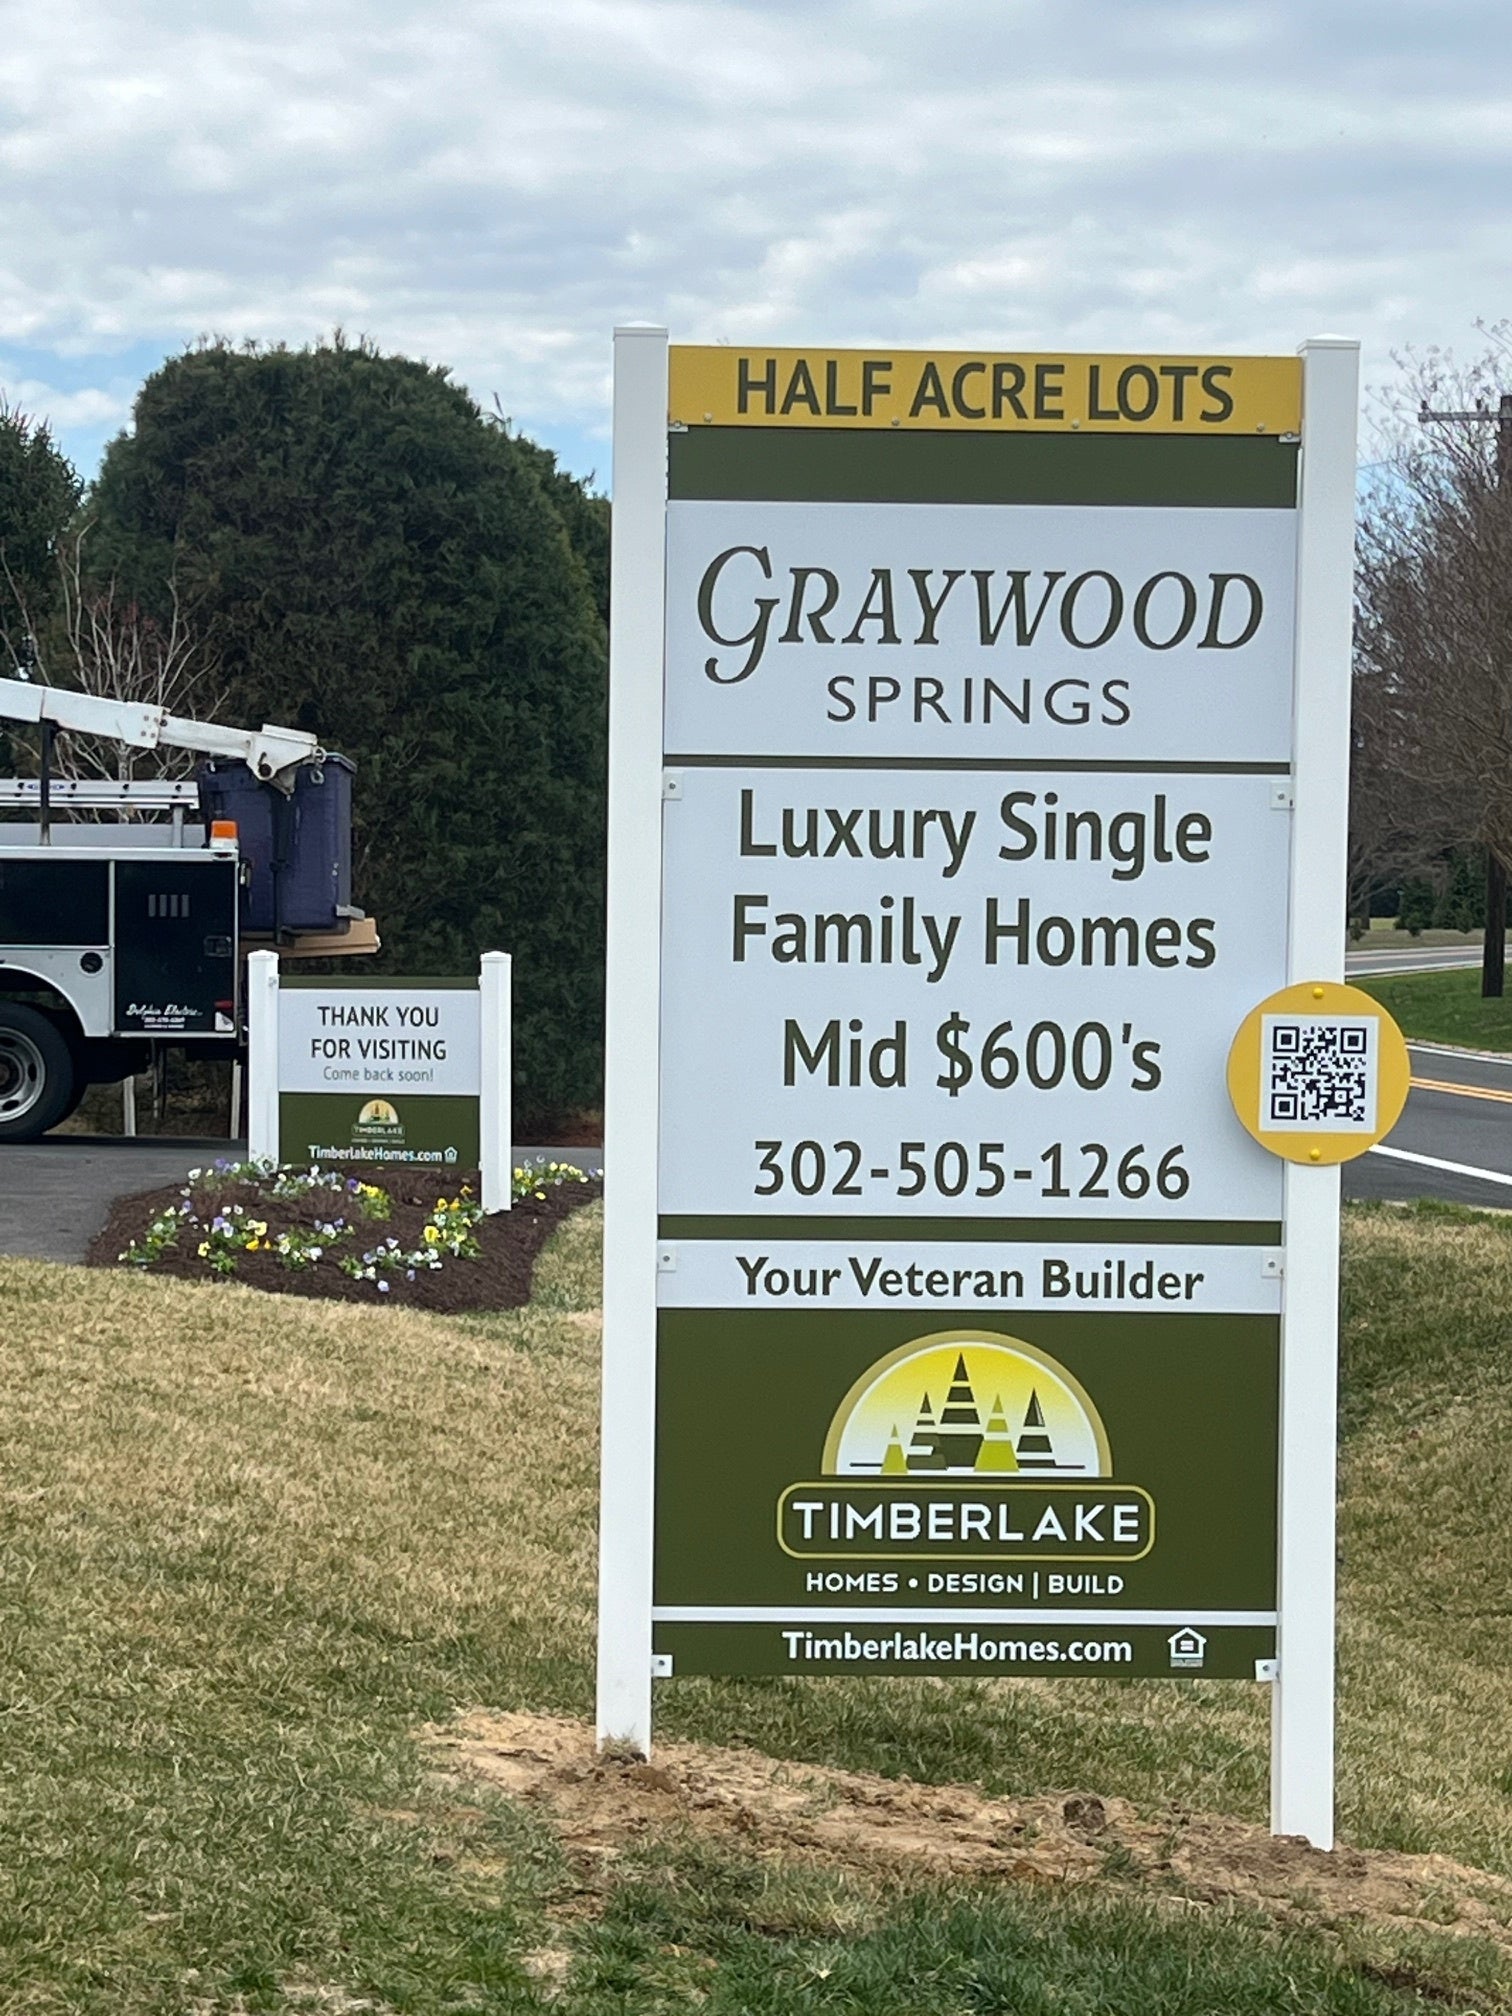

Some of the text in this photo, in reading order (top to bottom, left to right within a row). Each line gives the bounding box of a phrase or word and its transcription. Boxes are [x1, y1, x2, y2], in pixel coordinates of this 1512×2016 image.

[737, 357, 1234, 423] HALF ACRE LOTS
[697, 545, 1264, 684] GRAYWOOD
[827, 675, 1131, 726] SPRINGS
[739, 788, 1212, 882] Luxury Single
[732, 894, 1216, 984] Family Homes
[316, 1005, 439, 1028] THANK YOU
[311, 1038, 447, 1061] FOR VISITING
[783, 1011, 1162, 1098] Mid $600's
[323, 1065, 434, 1083] Come back soon!
[307, 1144, 443, 1162] TimberlakeHomes.com
[754, 1140, 1190, 1200] 302-505-1266
[735, 1256, 1205, 1301] Your Veteran Builder
[792, 1502, 1139, 1542] TIMBERLAKE
[806, 1572, 1124, 1594] HOMES DESIGN BUILD
[781, 1631, 1132, 1662] TimberlakeHomes.com
